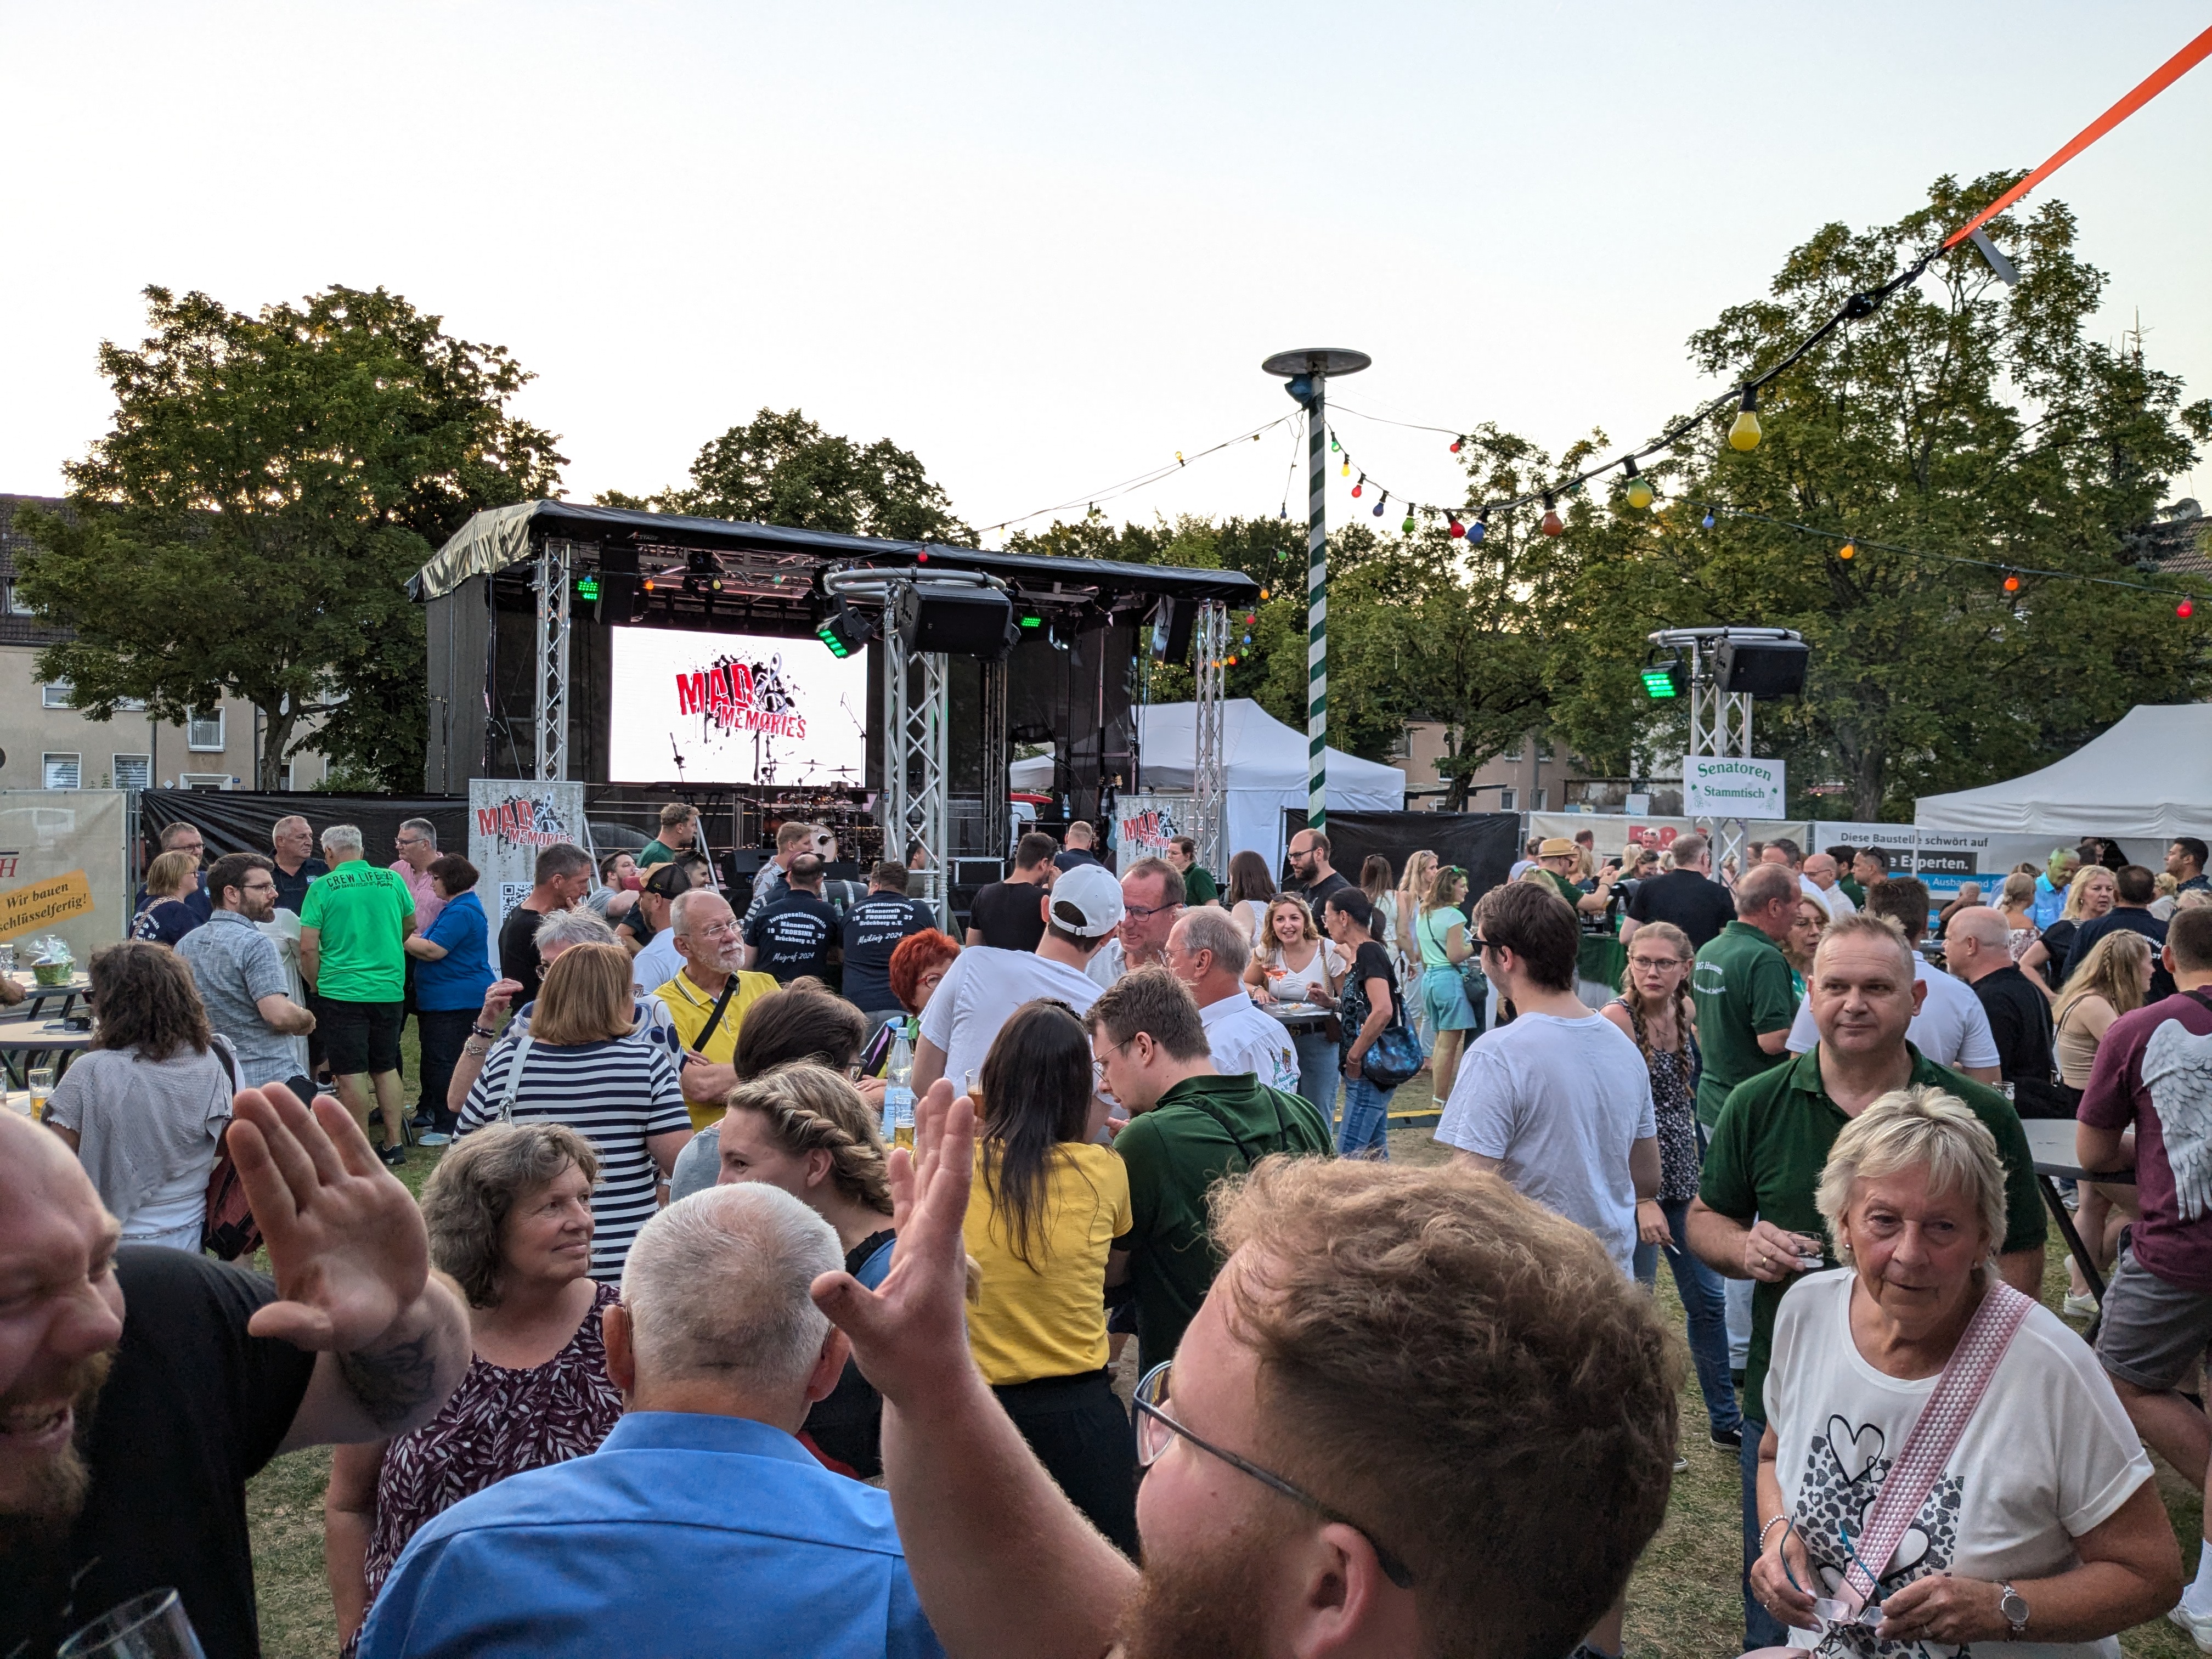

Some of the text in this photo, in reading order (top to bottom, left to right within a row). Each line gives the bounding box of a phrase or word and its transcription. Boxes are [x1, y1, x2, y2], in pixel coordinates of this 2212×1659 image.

[676, 663, 754, 715] MAD
[720, 706, 806, 738] MEMORIES
[1697, 761, 1771, 781] Senatoren
[1704, 785, 1765, 798] Stammtisch
[477, 800, 534, 837] MAD
[1123, 811, 1159, 843] MAD
[1841, 833, 1989, 848] Diese Baustelle schwört auf
[326, 873, 355, 887] CREW
[358, 871, 381, 882] LIFE
[6, 883, 69, 910] Wir bauen
[775, 935, 805, 944] Brückberg
[781, 928, 813, 938] FROHSINN
[885, 932, 903, 940] 2024
[798, 951, 815, 960] 2024
